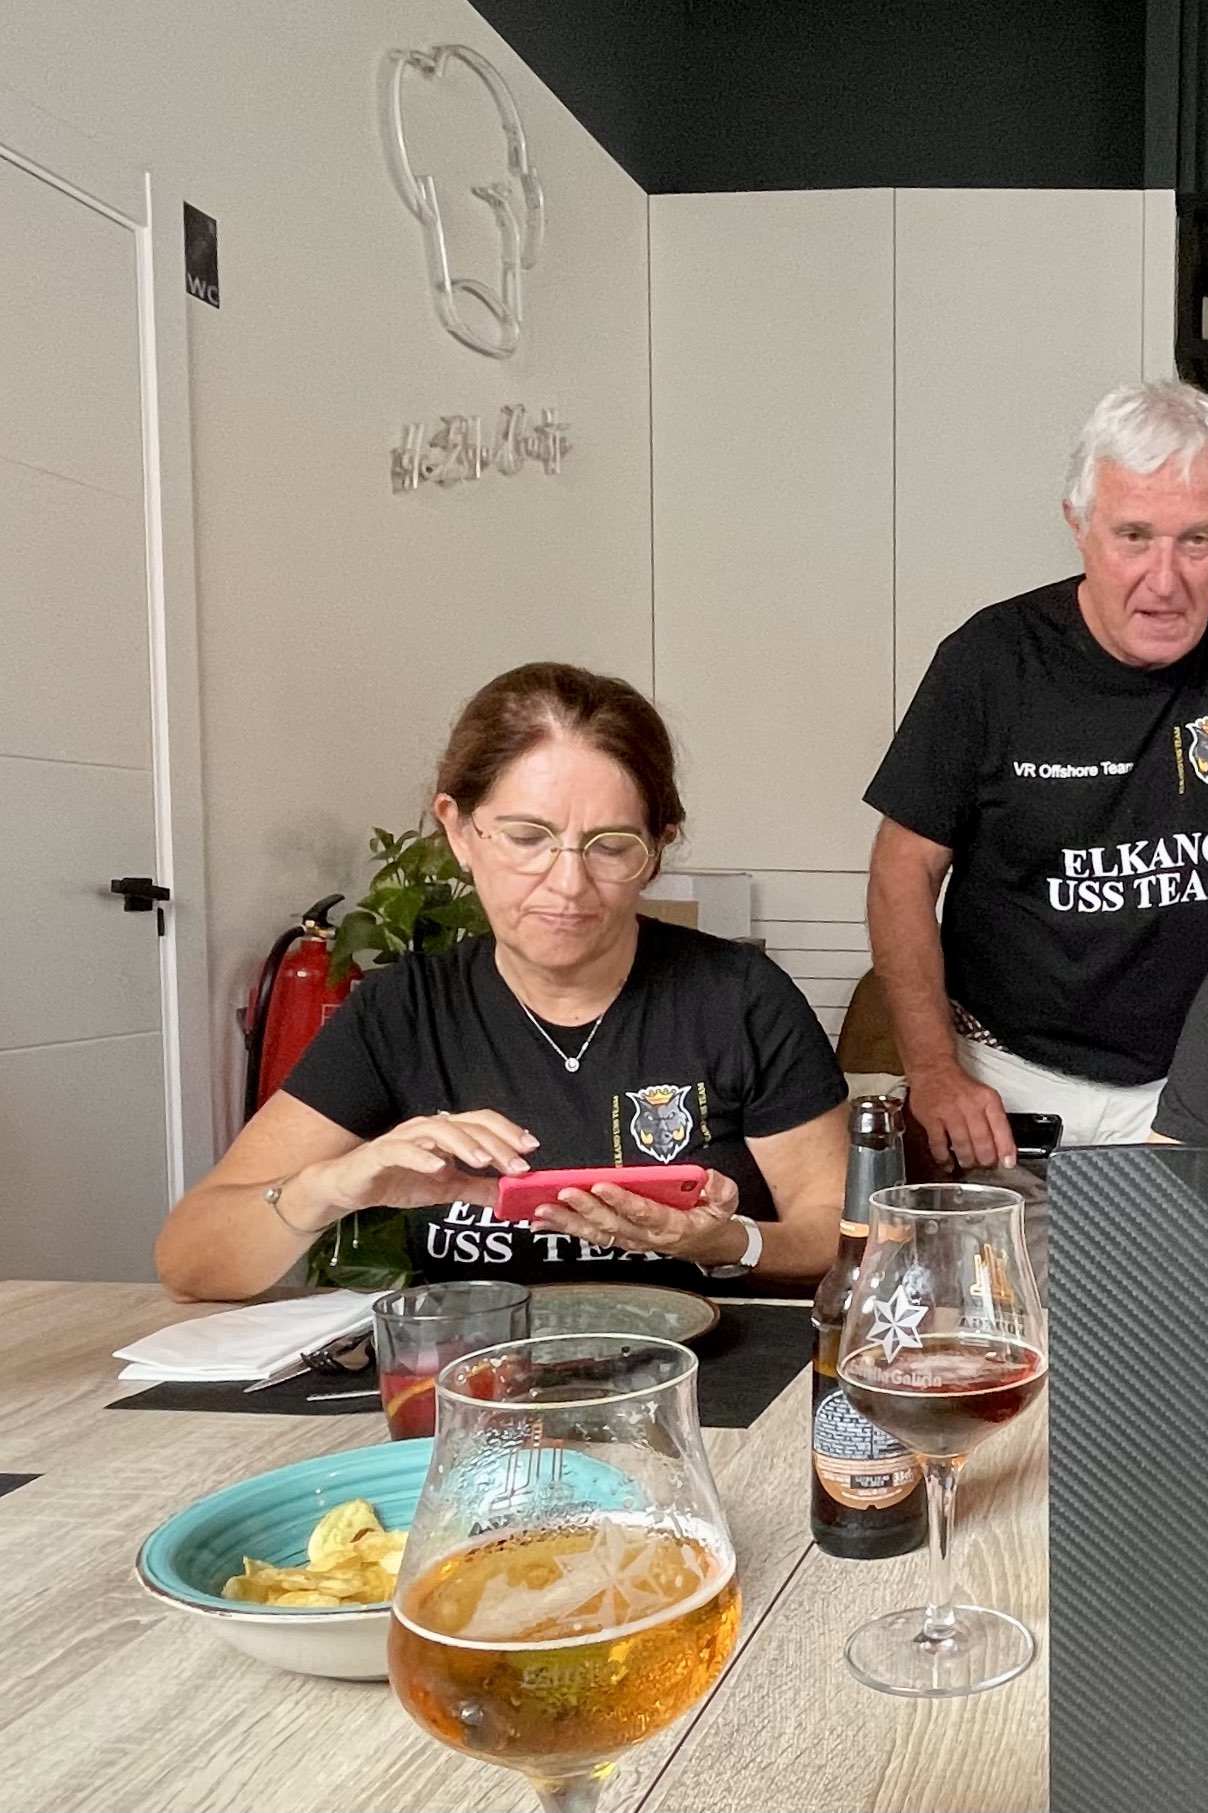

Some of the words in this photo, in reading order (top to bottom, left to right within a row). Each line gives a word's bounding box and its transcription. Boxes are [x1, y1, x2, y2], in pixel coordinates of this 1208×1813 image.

[187, 272, 219, 306] WC
[1013, 761, 1036, 778] VR
[1039, 763, 1099, 779] Offshore
[1046, 876, 1124, 913] USS
[427, 1222, 513, 1263] USS
